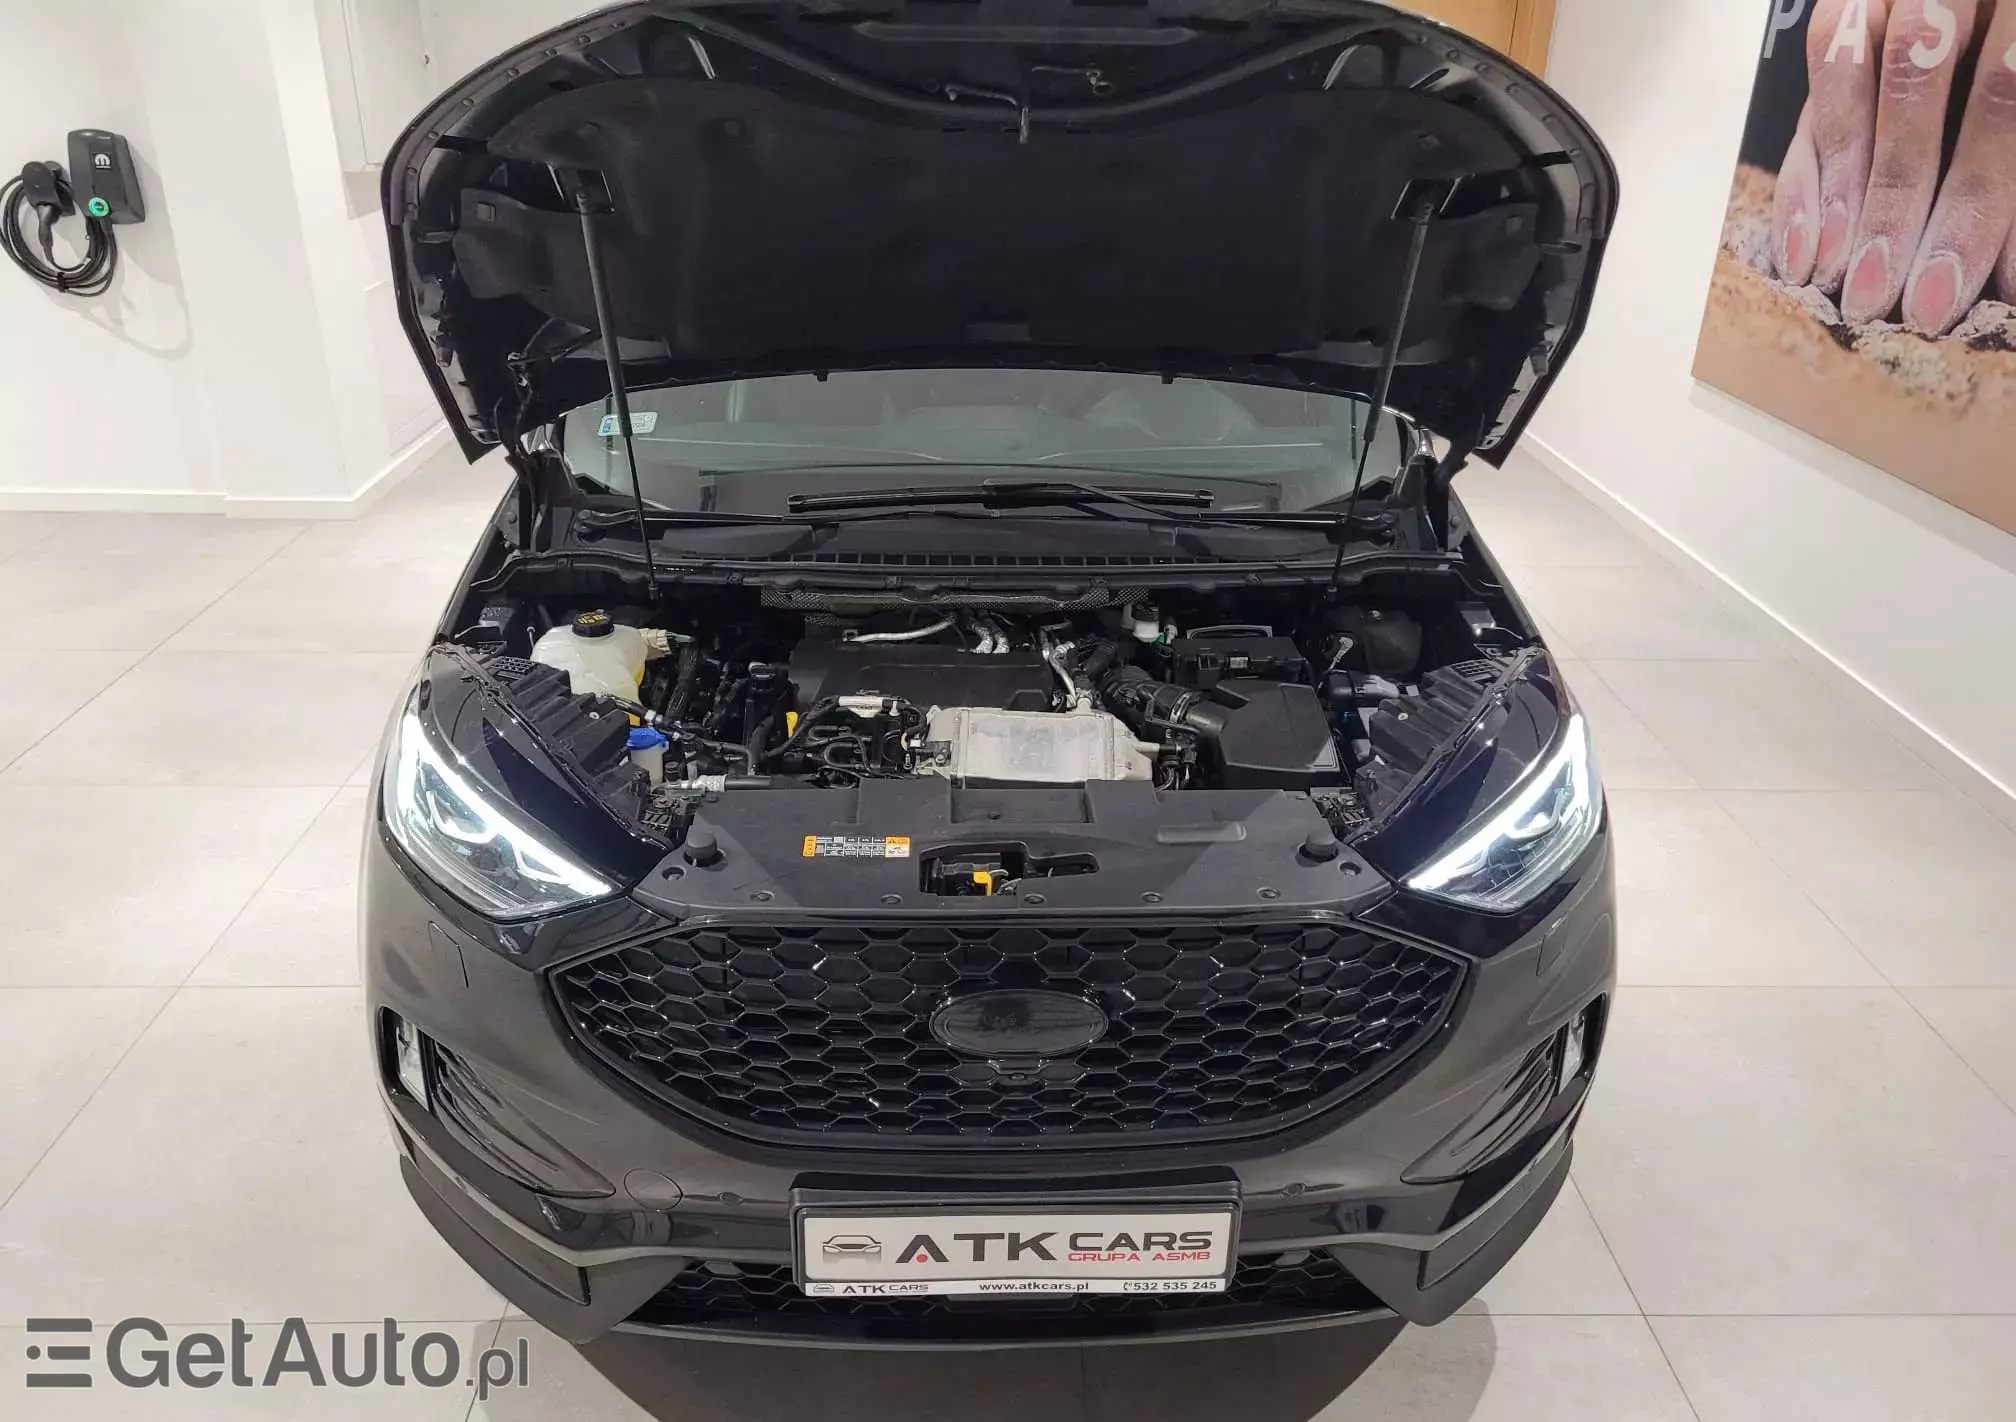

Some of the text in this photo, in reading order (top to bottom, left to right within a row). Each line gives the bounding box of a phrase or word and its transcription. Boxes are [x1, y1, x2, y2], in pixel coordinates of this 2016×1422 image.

[895, 1231, 1213, 1264] ATK CARS
[1068, 1251, 1210, 1262] GRUPA ASMB
[842, 1284, 929, 1295] ATK CARS
[979, 1280, 1089, 1292] www.atkcars.pl
[1133, 1280, 1217, 1291] 532 535 245
